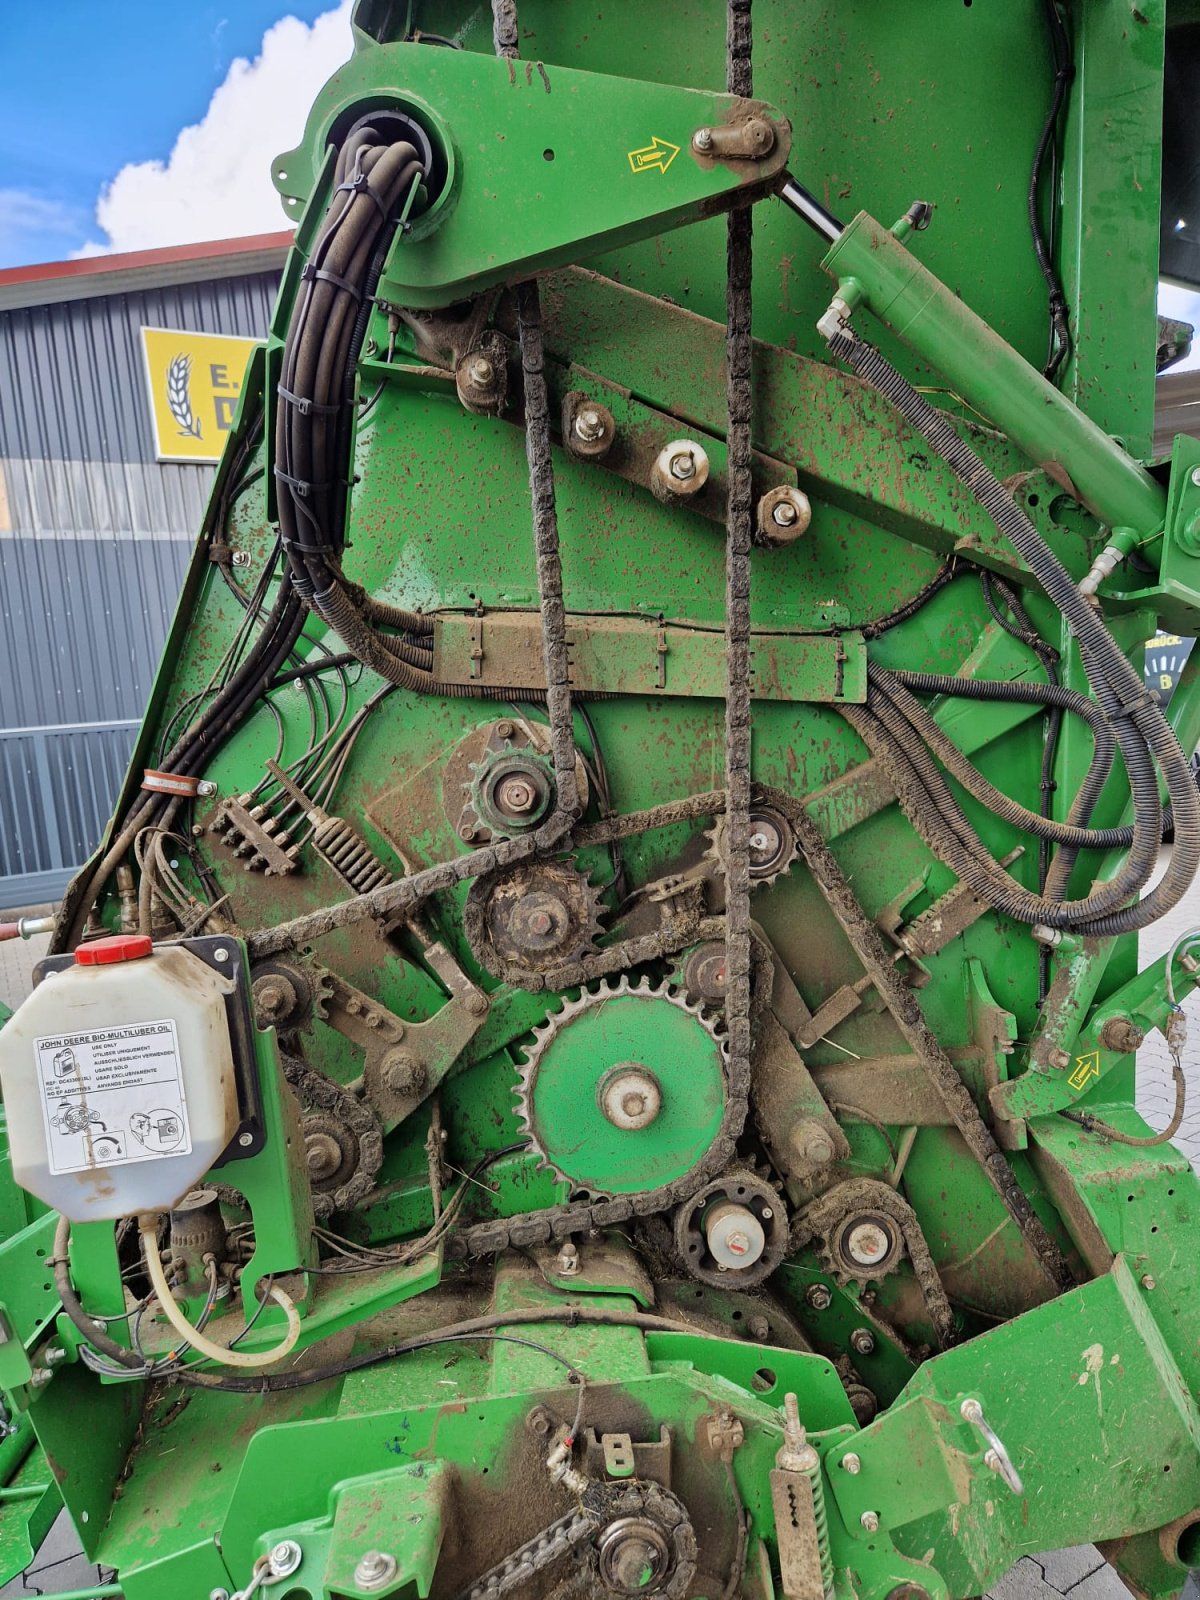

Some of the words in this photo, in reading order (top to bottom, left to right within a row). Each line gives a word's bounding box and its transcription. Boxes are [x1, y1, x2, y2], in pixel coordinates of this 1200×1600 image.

[209, 364, 239, 388] E.
[41, 1040, 61, 1049] JOHN
[64, 1036, 89, 1046] DEERE
[92, 1027, 156, 1041] BIO-MULTILUBER
[93, 1050, 117, 1058] UTILISER
[117, 1045, 151, 1054] UNIQUEMENT
[142, 1050, 174, 1059] VERWENDEN
